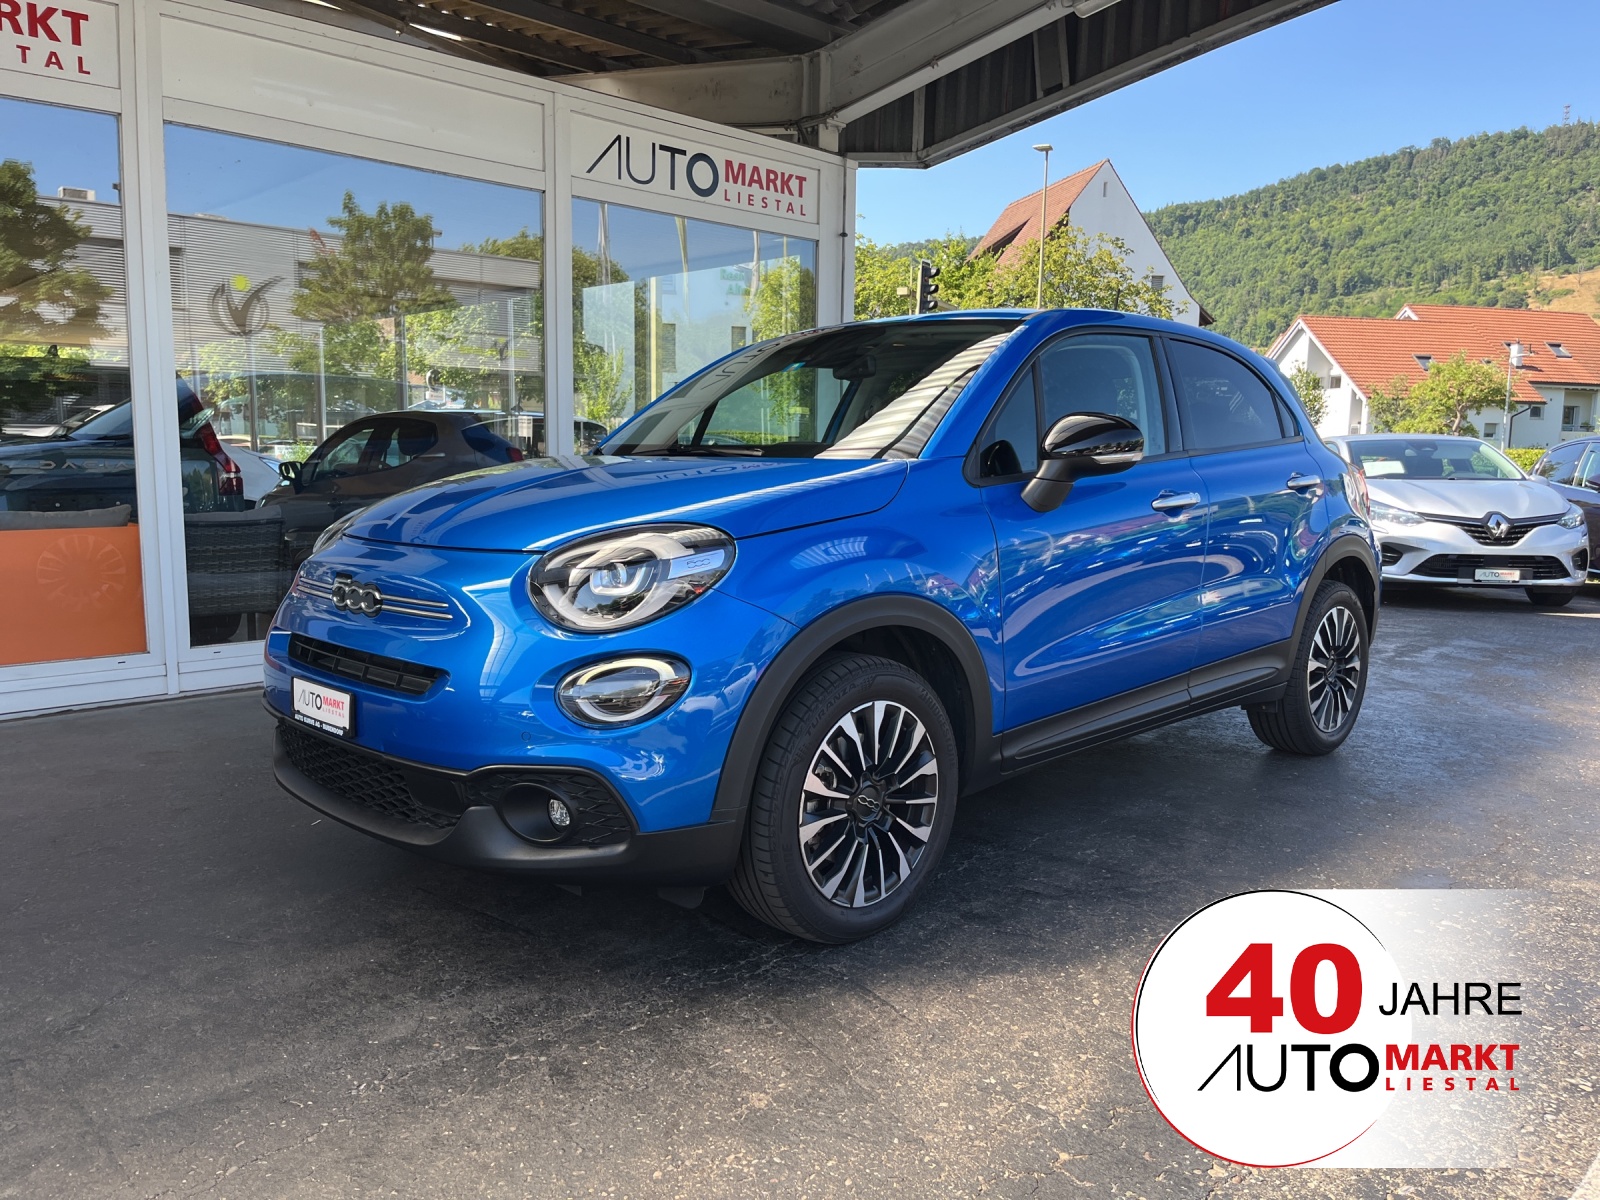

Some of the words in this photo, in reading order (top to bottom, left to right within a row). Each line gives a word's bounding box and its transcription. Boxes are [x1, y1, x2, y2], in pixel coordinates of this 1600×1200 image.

[0, 0, 89, 46] RKT
[16, 44, 91, 75] TAL
[724, 189, 807, 216] LIESTAL
